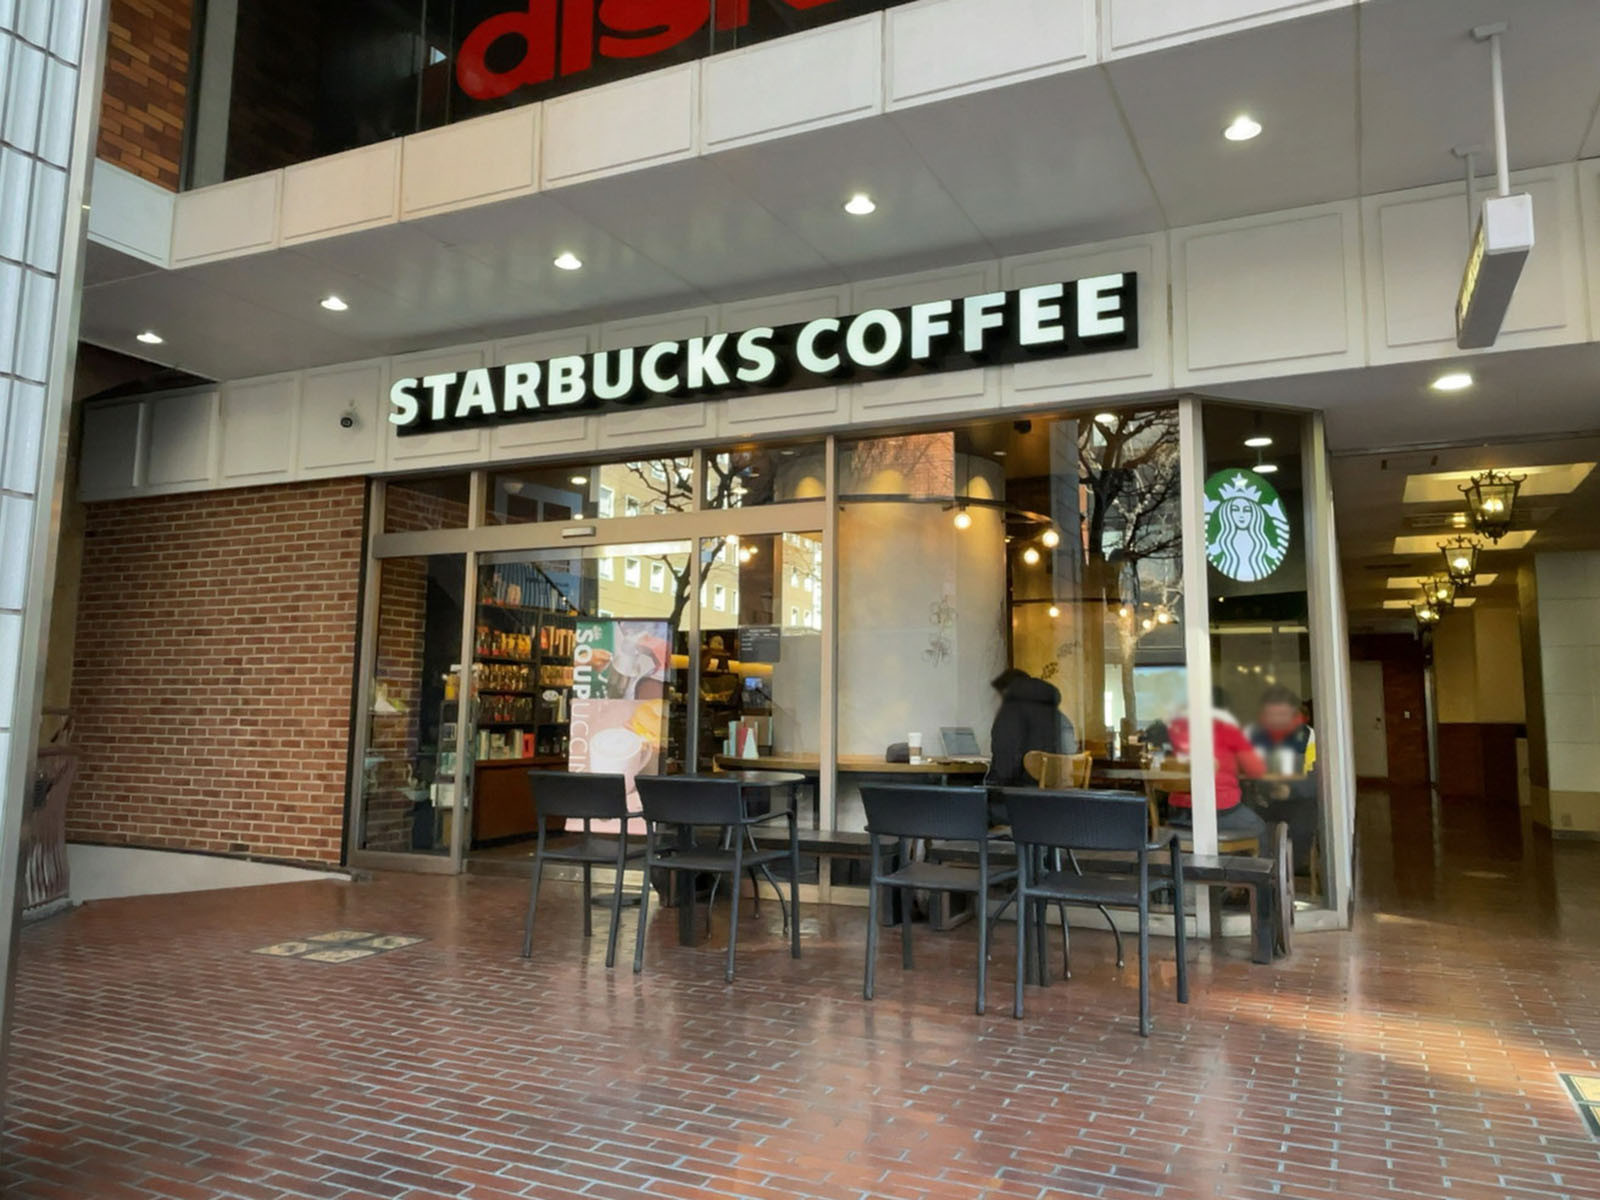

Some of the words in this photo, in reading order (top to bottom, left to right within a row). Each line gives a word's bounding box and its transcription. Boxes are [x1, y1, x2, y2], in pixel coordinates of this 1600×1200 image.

[457, 0, 838, 100] dis
[389, 327, 776, 426] STARBUCKS
[796, 272, 1125, 373] COFFEE
